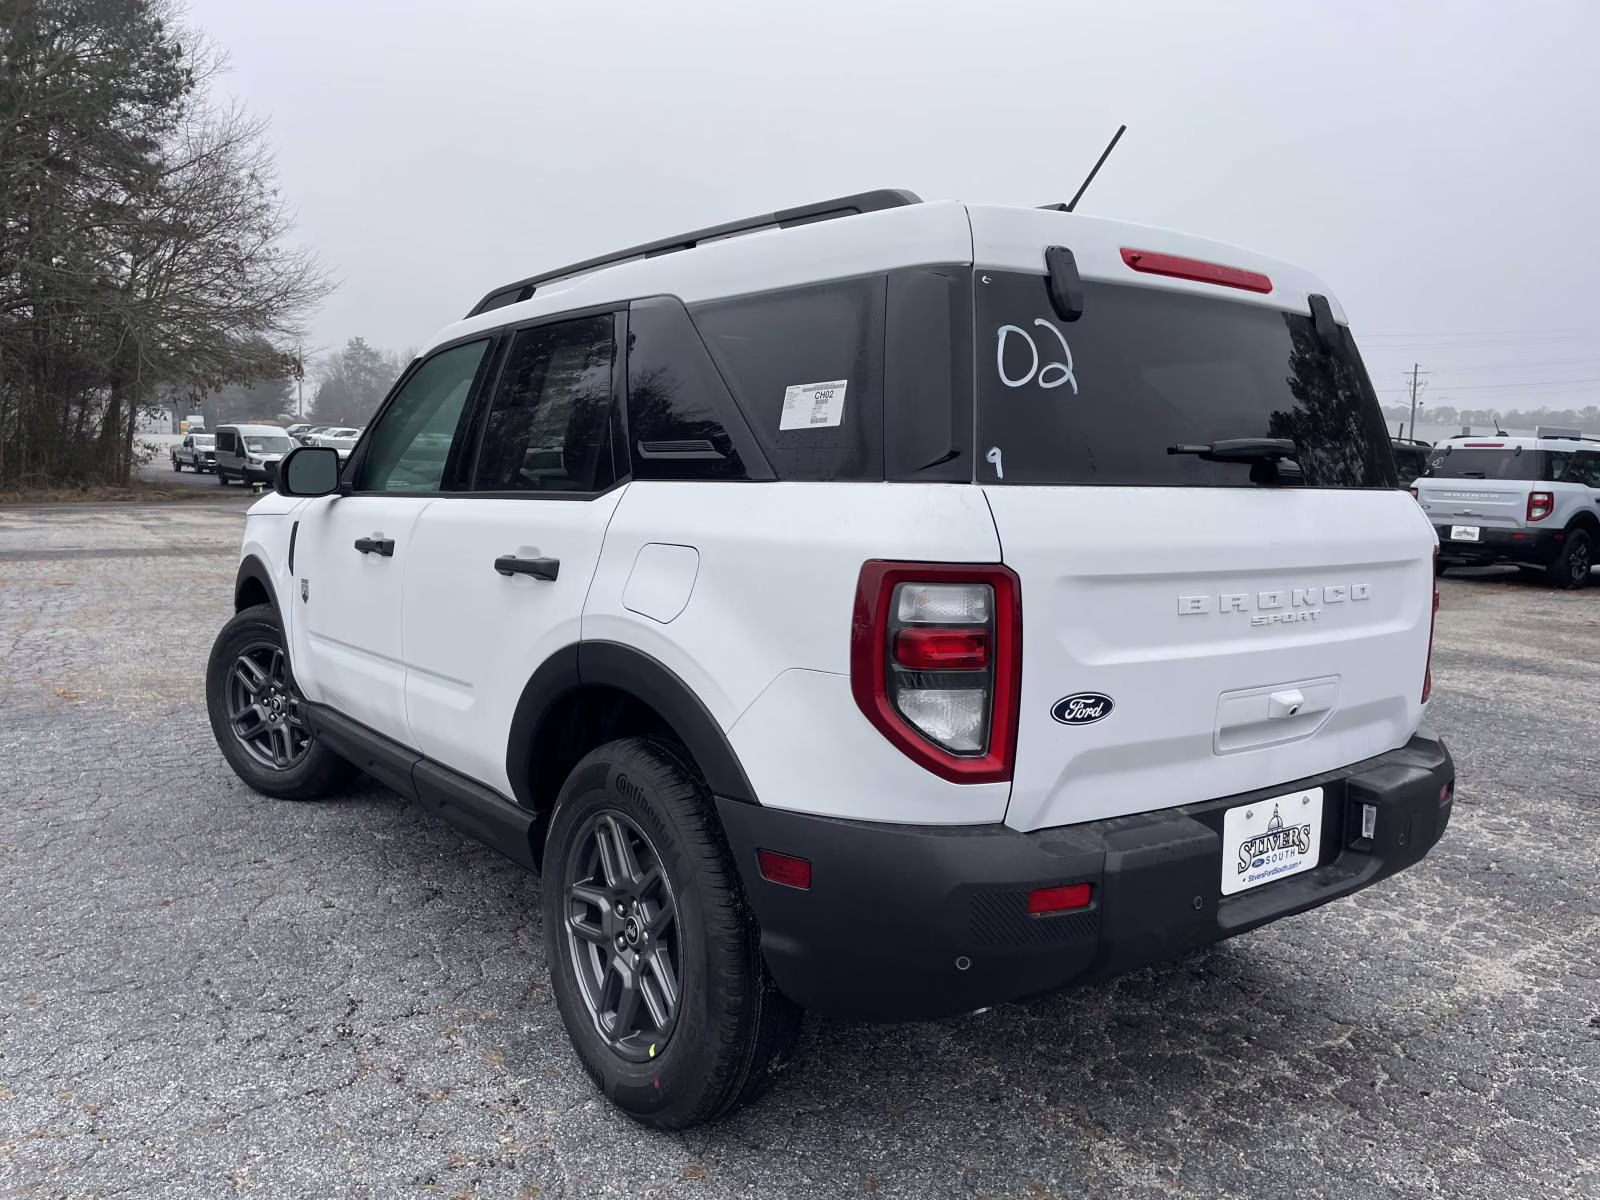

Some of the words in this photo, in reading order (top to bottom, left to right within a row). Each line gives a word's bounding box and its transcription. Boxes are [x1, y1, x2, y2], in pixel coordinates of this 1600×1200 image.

[997, 318, 1078, 395] 02
[815, 390, 834, 400] CH02
[986, 447, 1003, 479] 9
[1178, 584, 1371, 615] BRONCO
[1251, 610, 1320, 626] SPORT
[1237, 824, 1311, 875] STIVERS
[1265, 848, 1296, 865] SOUTH
